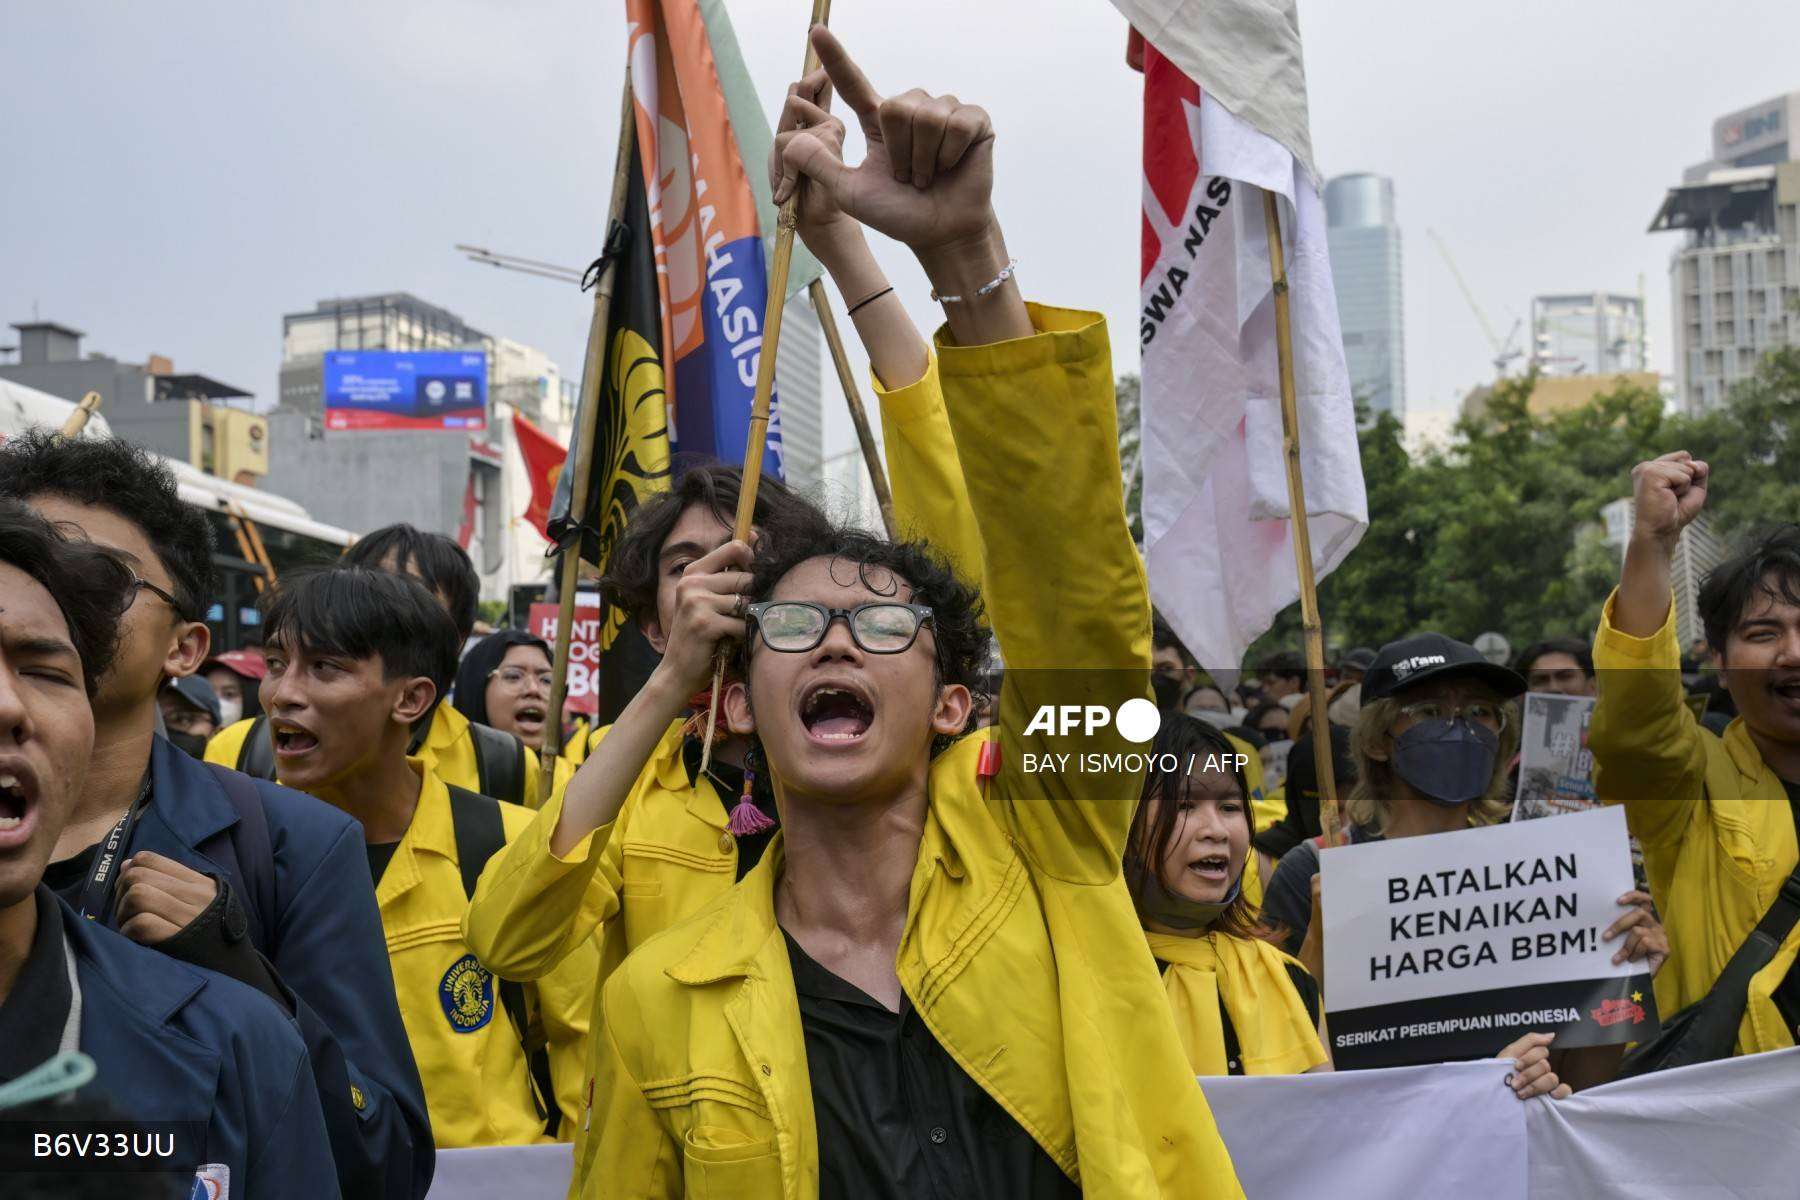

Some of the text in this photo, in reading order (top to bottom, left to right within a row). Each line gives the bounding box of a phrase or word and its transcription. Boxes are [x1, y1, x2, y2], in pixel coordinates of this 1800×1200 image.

[94, 853, 114, 883] BEM
[1387, 853, 1578, 904] BATALKAN
[1390, 892, 1578, 942] KENAIKAN
[1369, 926, 1598, 981] HARGA BBM!
[1336, 1027, 1398, 1048] SERIKAT
[1400, 1016, 1492, 1039] PEREMPUAN
[1494, 1007, 1581, 1028] INDONESIA
